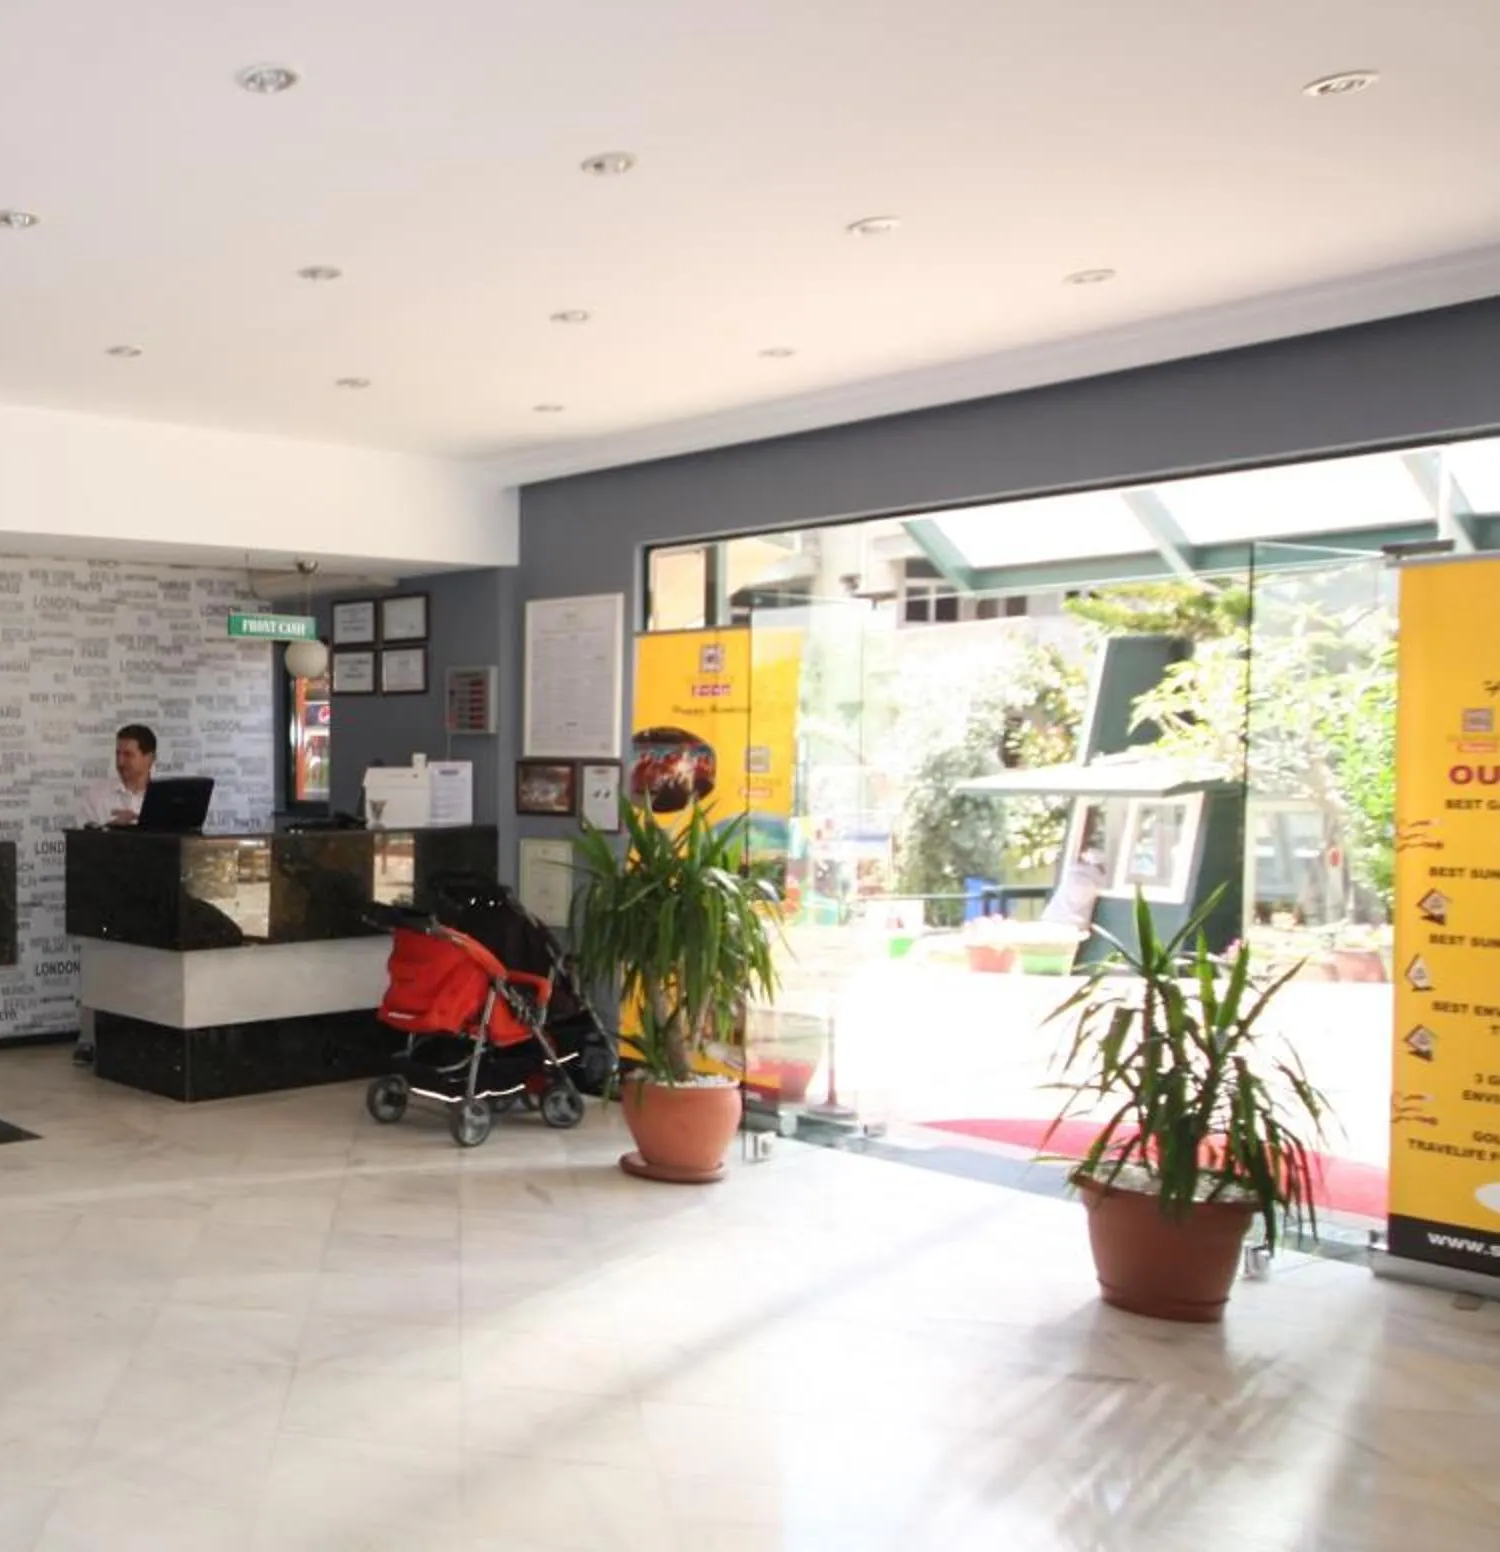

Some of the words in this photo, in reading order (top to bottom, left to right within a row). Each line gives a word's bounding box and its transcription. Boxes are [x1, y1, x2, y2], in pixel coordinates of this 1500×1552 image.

[1445, 799, 1482, 810] BEST
[1429, 866, 1466, 878] BEST
[1429, 933, 1466, 946] BEST
[35, 960, 81, 976] LONDON
[1432, 1001, 1469, 1014] BEST
[1408, 1138, 1486, 1162] TRAVELIFE
